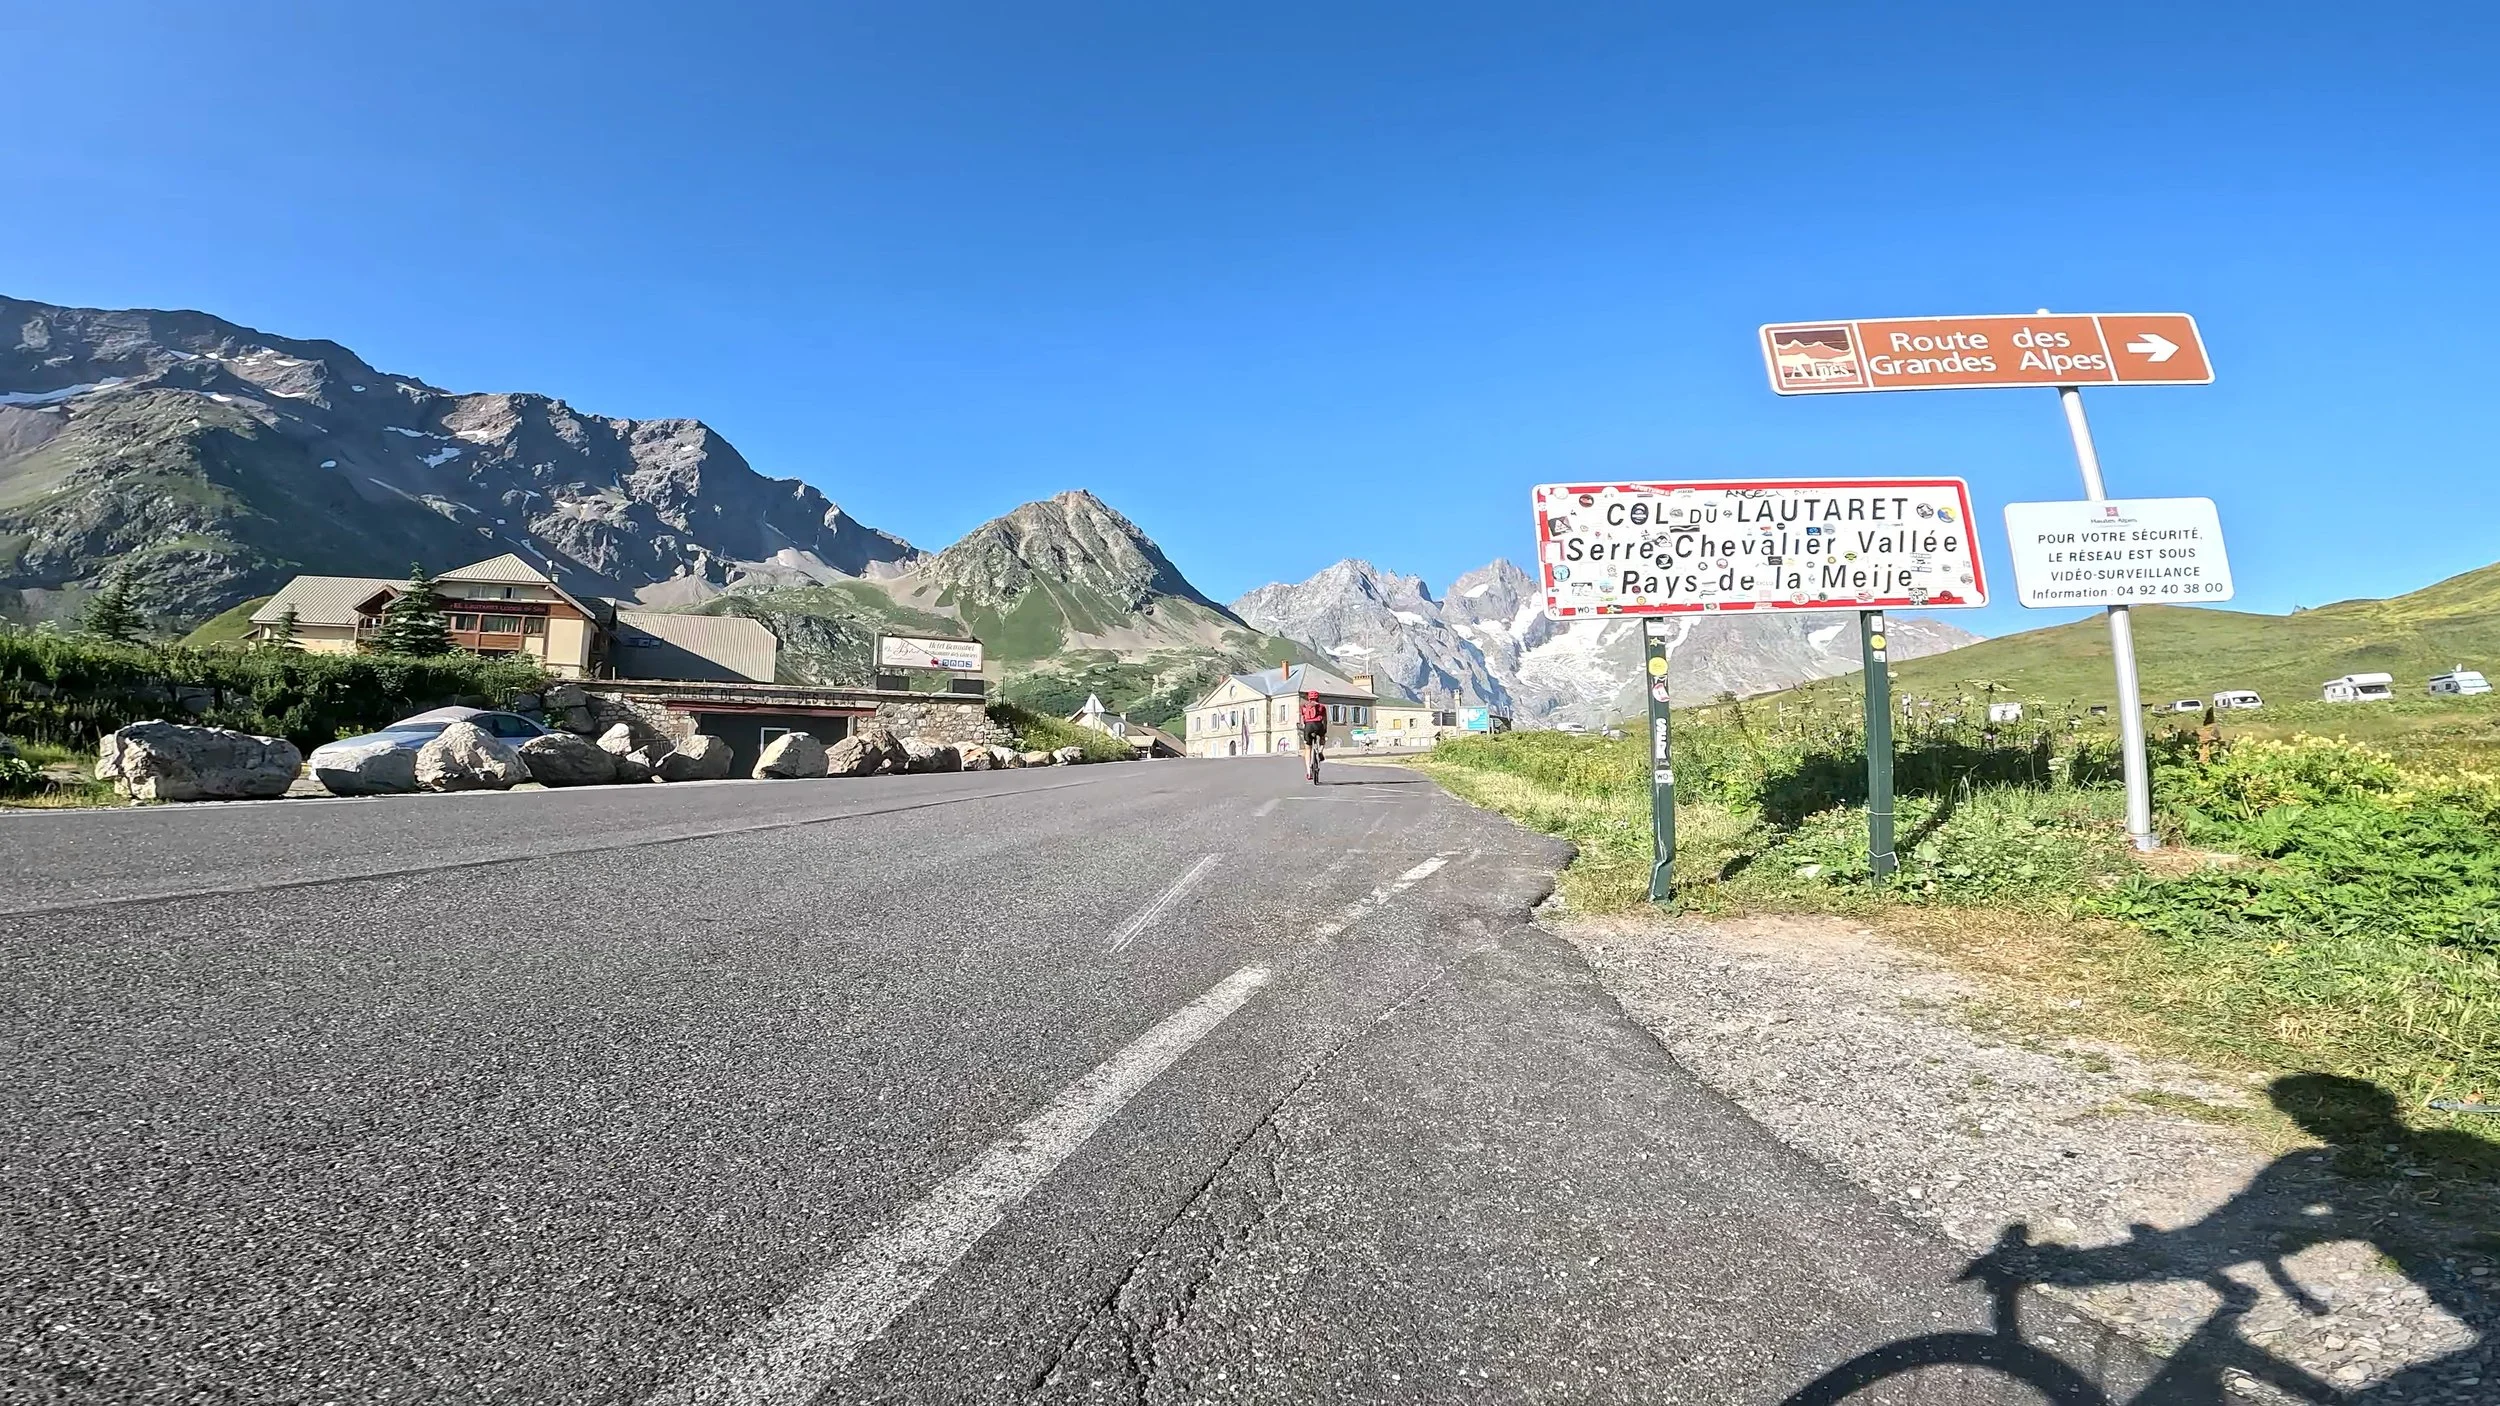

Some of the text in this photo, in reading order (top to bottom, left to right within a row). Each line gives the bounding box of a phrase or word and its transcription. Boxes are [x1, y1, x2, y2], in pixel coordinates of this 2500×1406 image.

[1889, 327, 2070, 352] Route des
[1788, 359, 1853, 382] Alpes
[1869, 349, 2107, 375] Grandes Alpes
[1607, 498, 1908, 526] COL DU LAUTARET
[1566, 530, 1957, 561] Serre Chevalier Vallée
[2038, 527, 2203, 544] POUR VOTRE SÉCURITÉ,
[2048, 548, 2196, 563] LE RÉSEAU EST SOUS
[1621, 564, 1913, 598] Pays de la Meije
[2051, 566, 2201, 581] VIDÉO-SURVEILLANCE
[2033, 588, 2107, 599] Information
[2117, 586, 2134, 596] 04
[2139, 585, 2156, 595] 92
[2161, 584, 2178, 594] 40
[2183, 583, 2200, 594] 38
[2205, 583, 2223, 593] 00
